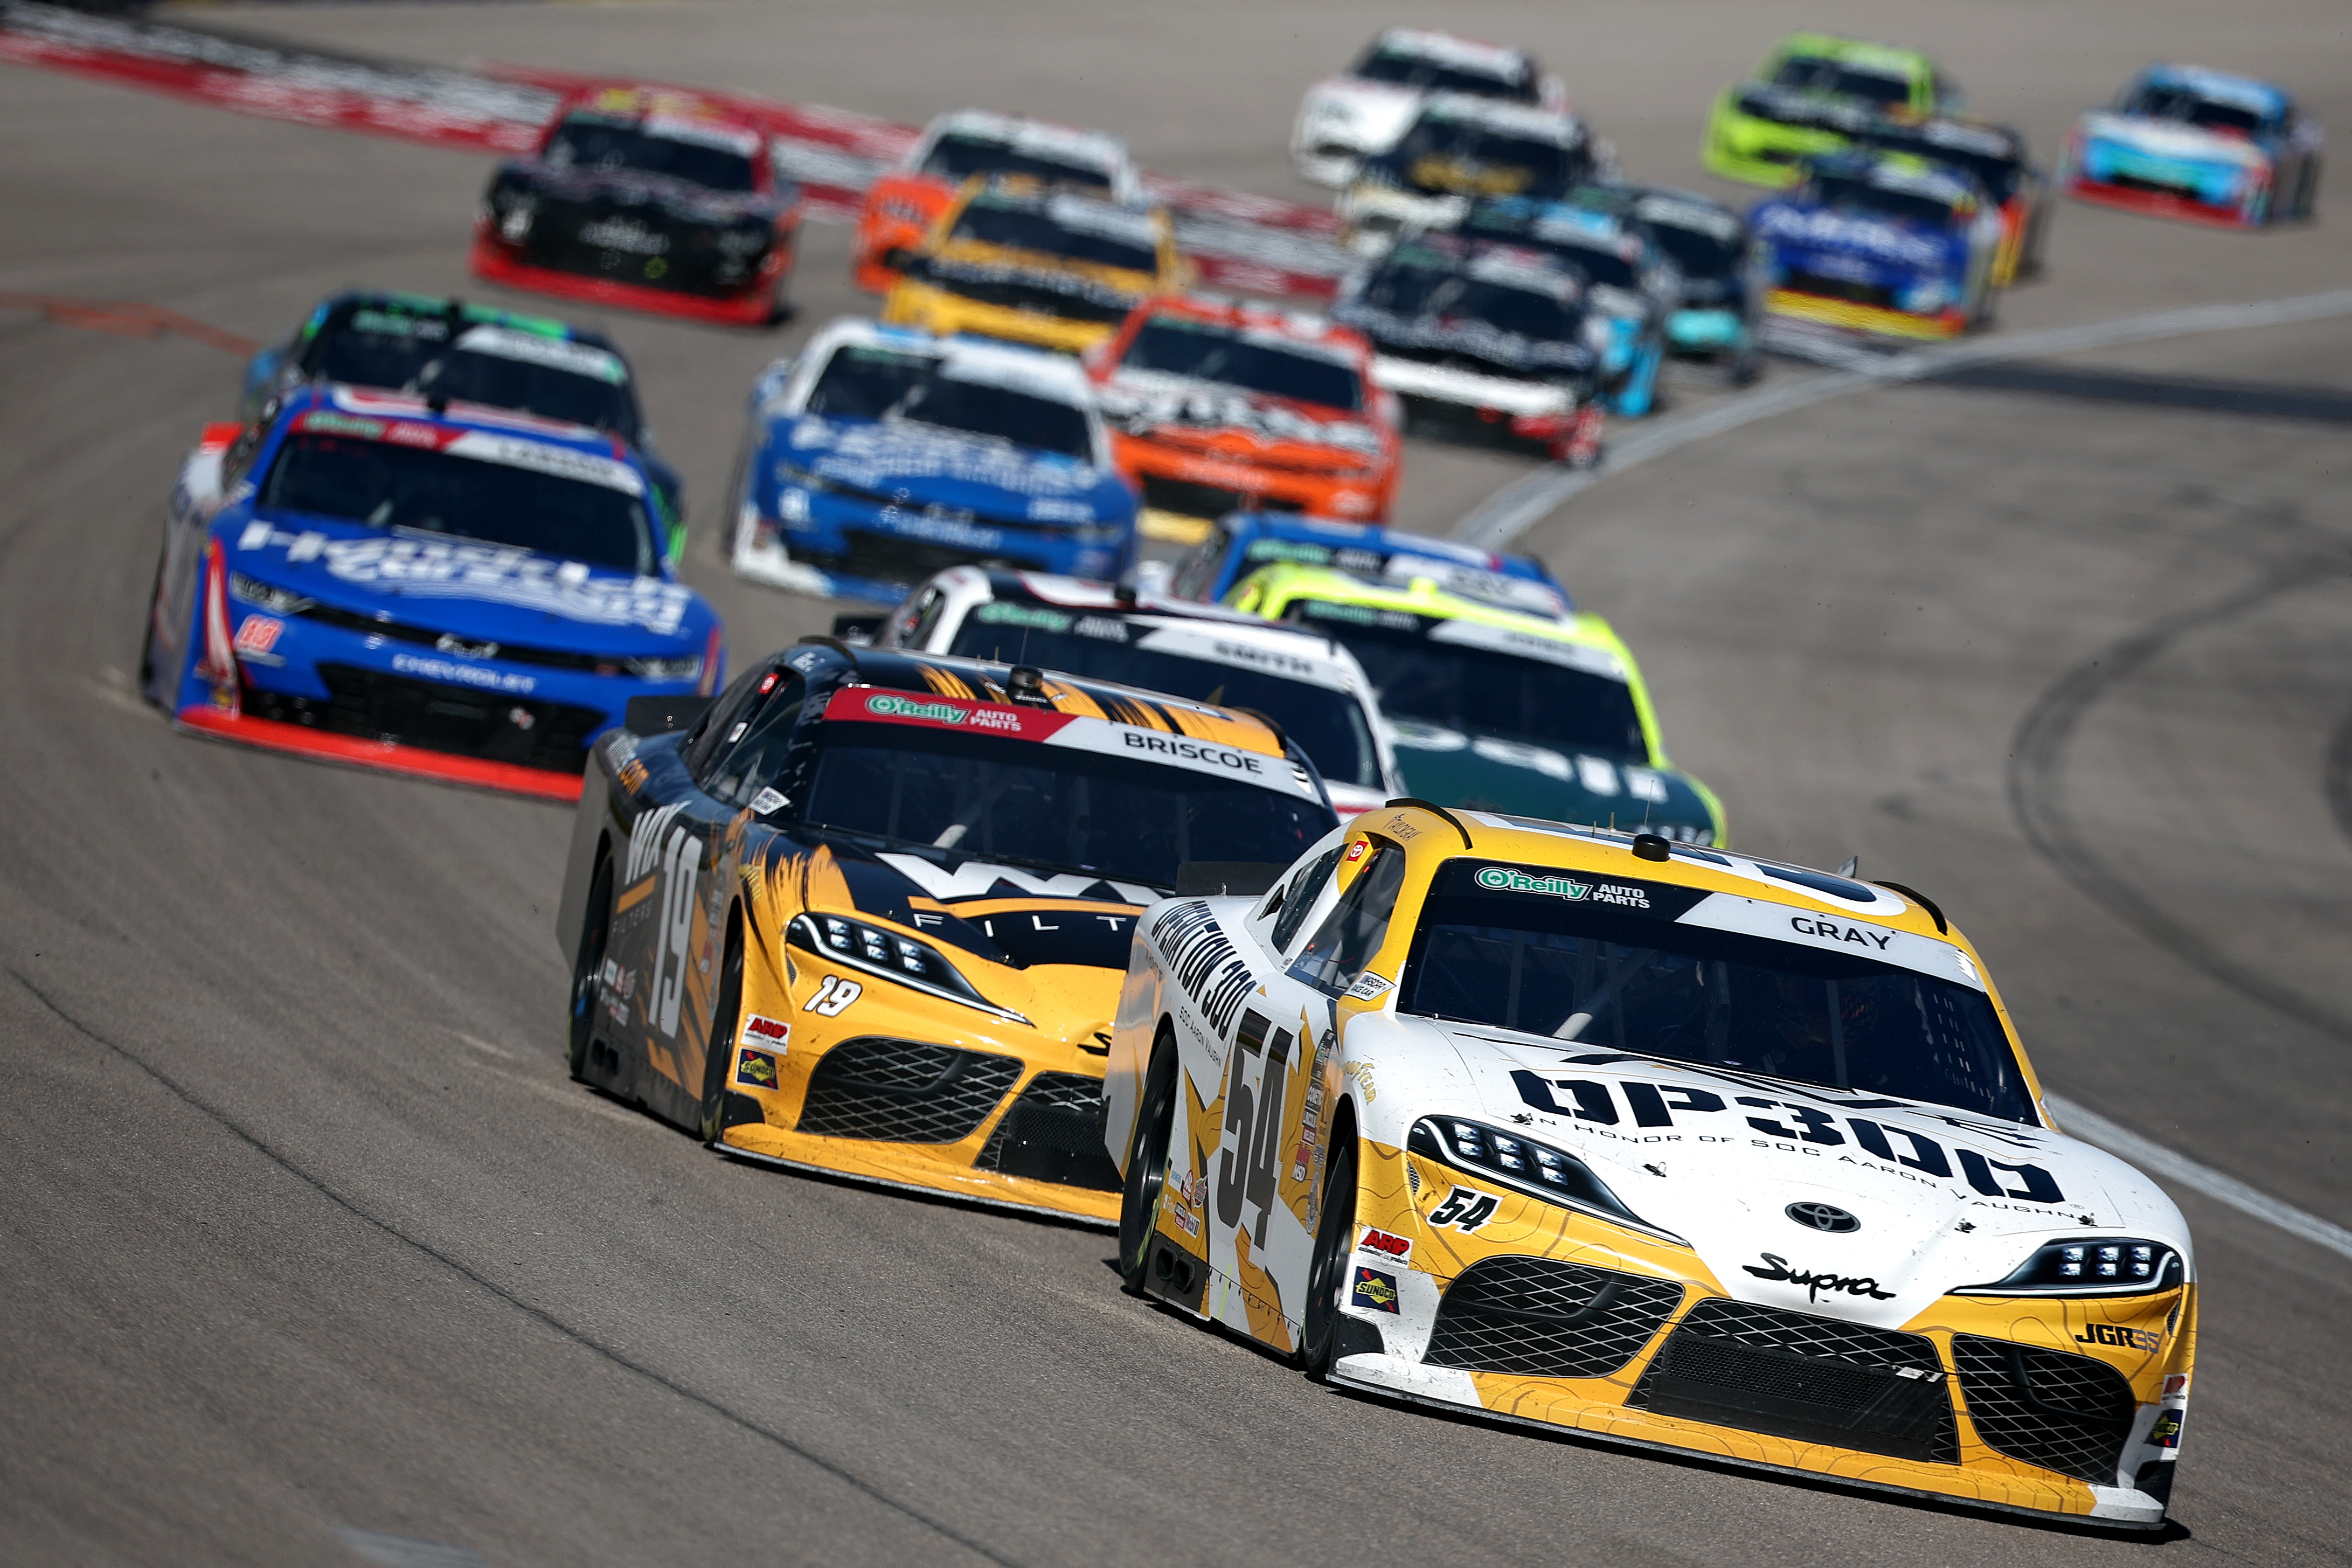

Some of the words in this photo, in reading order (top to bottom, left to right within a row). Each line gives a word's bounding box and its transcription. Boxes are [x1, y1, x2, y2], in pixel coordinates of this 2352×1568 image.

[869, 695, 967, 723] O'Reilly
[976, 709, 1018, 722] AUTO
[970, 716, 1022, 732] PARTS
[1124, 732, 1263, 774] BRISCOE
[1479, 868, 1590, 899] O'Reilly
[1599, 884, 1645, 898] AUTO
[1593, 892, 1650, 908] PARTS
[648, 825, 703, 1038] 19
[913, 913, 1127, 938] FILT
[1792, 917, 1890, 950] GRAY
[803, 974, 863, 1018] 19
[1201, 960, 1257, 1042] 300
[748, 1017, 787, 1039] ARP
[1217, 1007, 1294, 1251] 54
[1292, 1164, 1308, 1183] MSD
[1573, 1124, 1682, 1143] HONOR
[1751, 1139, 1821, 1157] SOC
[1837, 1155, 1937, 1189] AARON
[1948, 1187, 2075, 1219] VAUGHN
[1429, 1187, 1499, 1232] 54
[1361, 1229, 1410, 1256] ARP
[1358, 1282, 1395, 1300] SUNOCO
[1742, 1252, 1897, 1305] Supra
